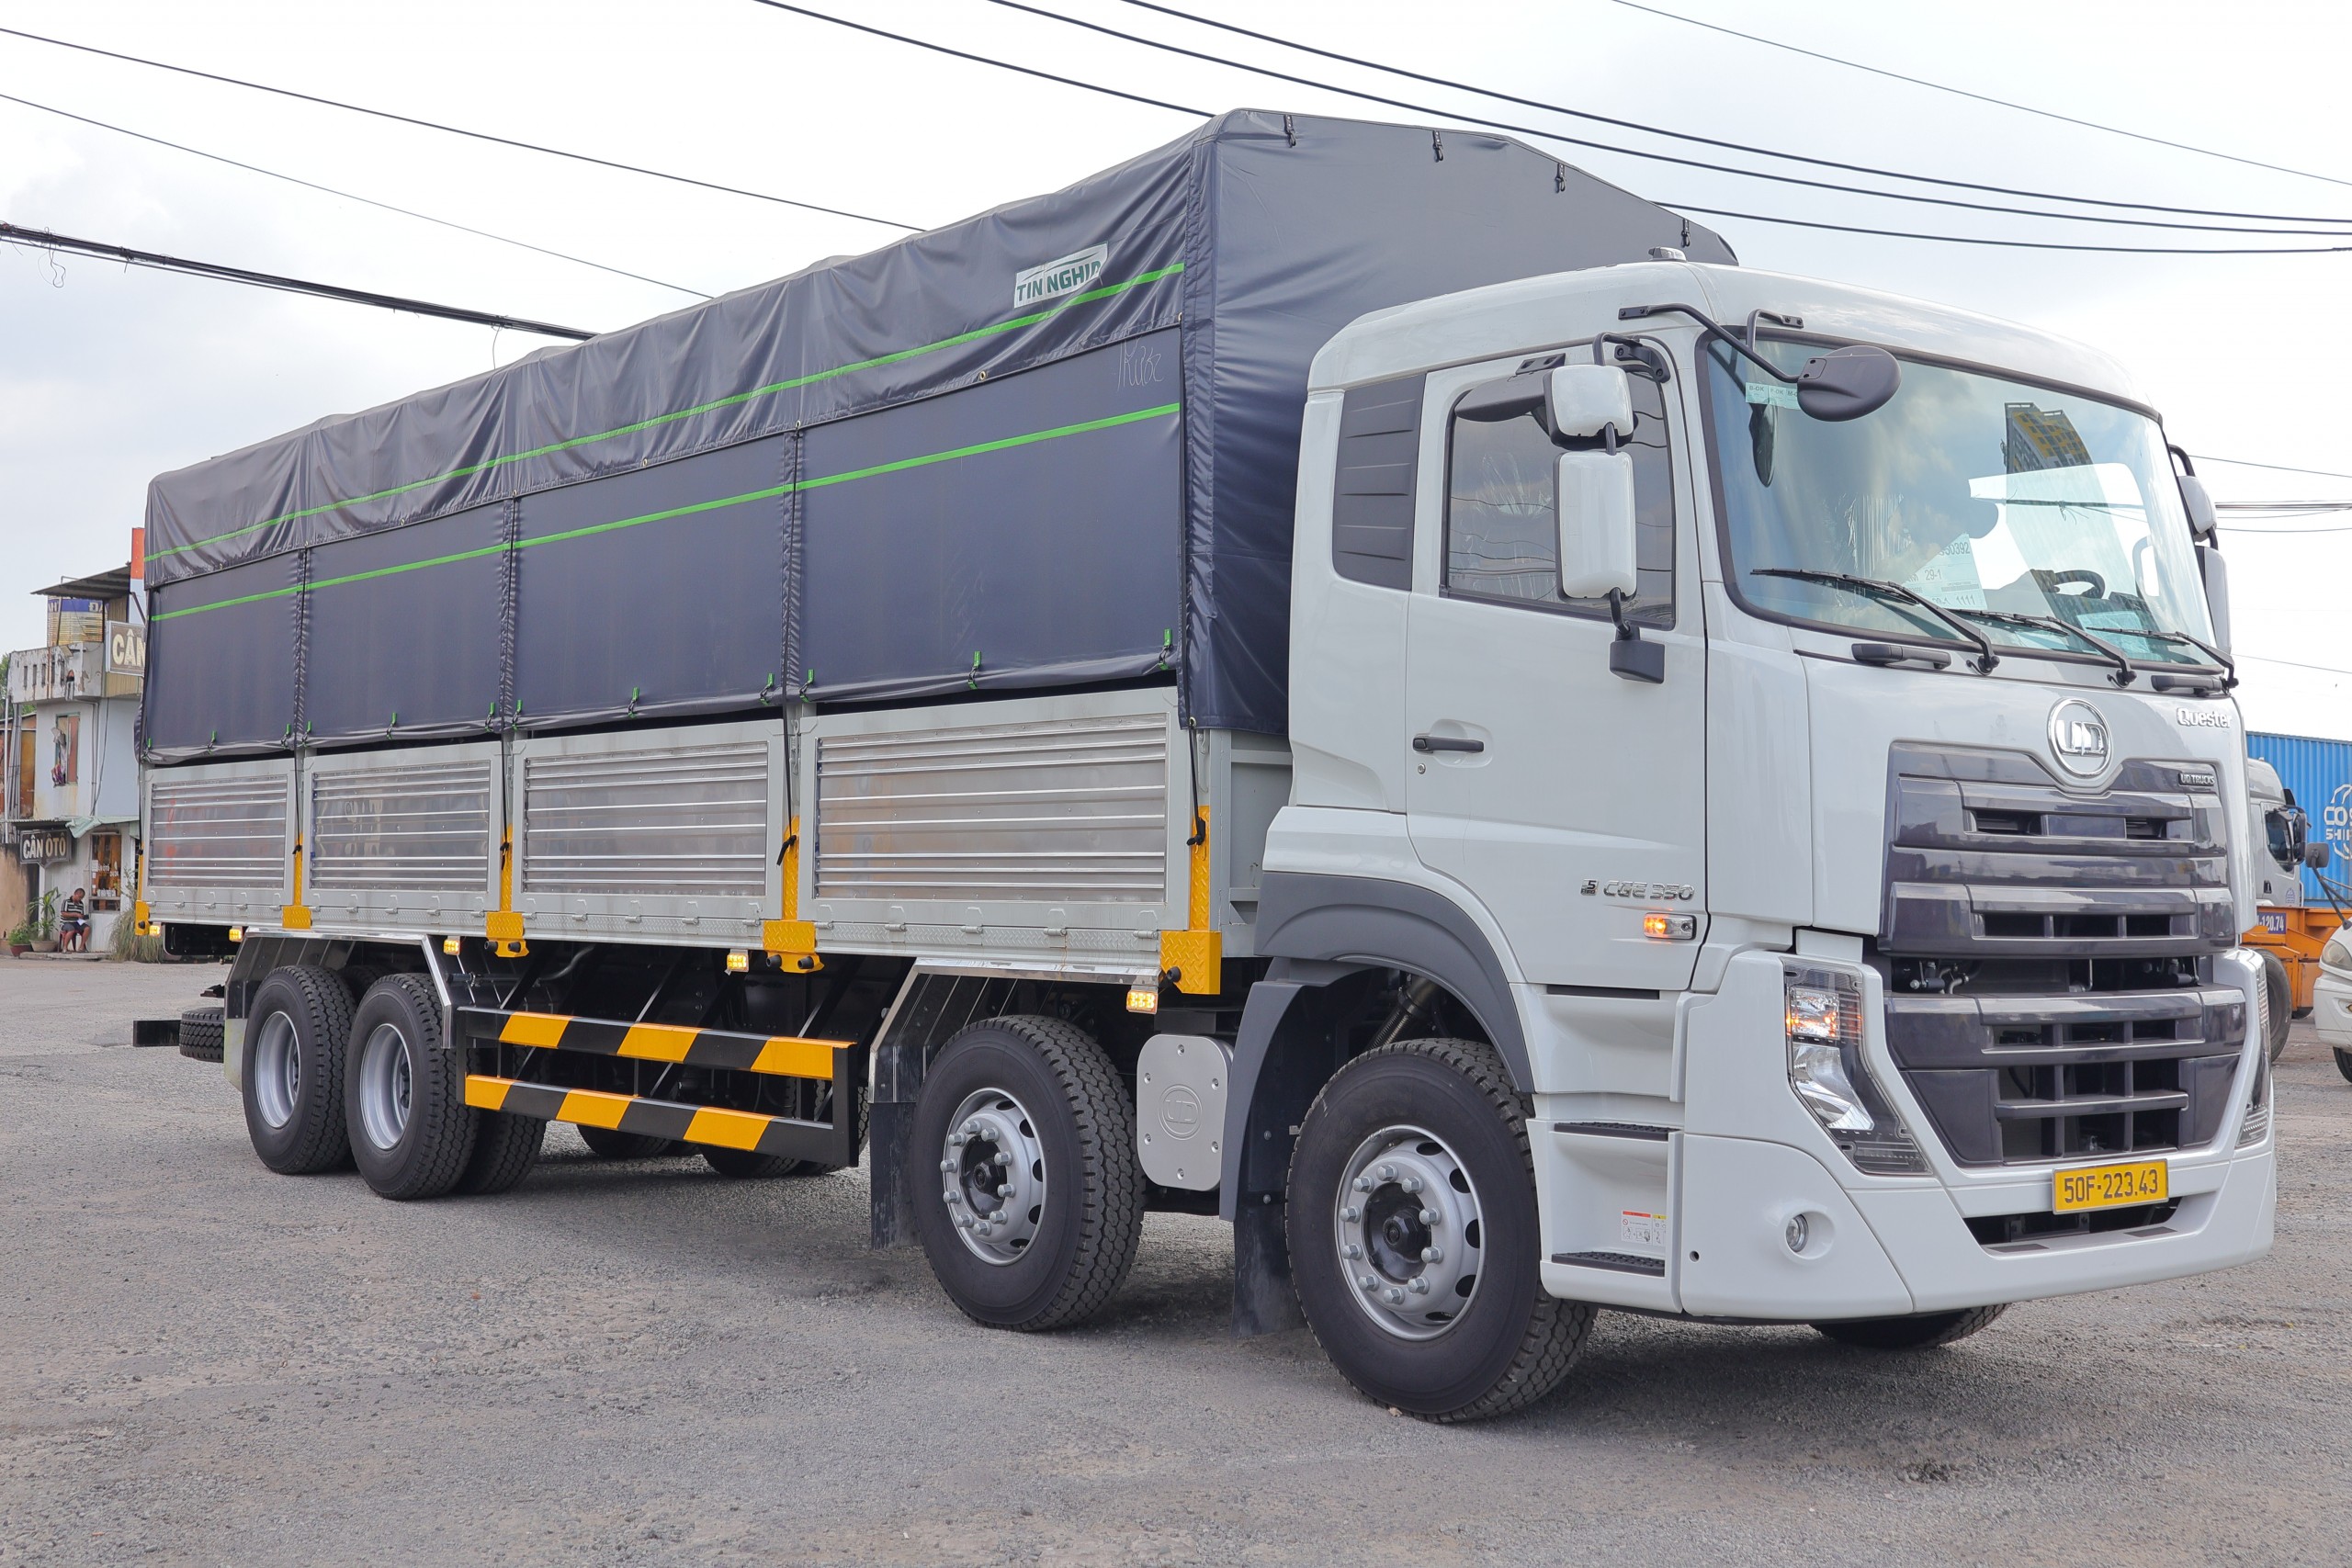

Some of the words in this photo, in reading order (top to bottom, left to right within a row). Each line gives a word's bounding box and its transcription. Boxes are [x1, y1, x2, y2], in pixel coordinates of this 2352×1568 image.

[1016, 278, 1043, 301] TIN
[112, 628, 146, 667] CÂN
[2177, 707, 2233, 728] Quester
[2055, 720, 2108, 756] UD
[2191, 774, 2215, 785] TRUCKS
[2324, 806, 2352, 827] CO
[23, 834, 43, 859] CÂN
[45, 832, 66, 857] ÔTÔ
[1588, 880, 1597, 890] 5
[1603, 881, 1647, 898] CGE
[1650, 884, 1695, 900] 350
[2064, 1169, 2158, 1203] 50F-223.43
